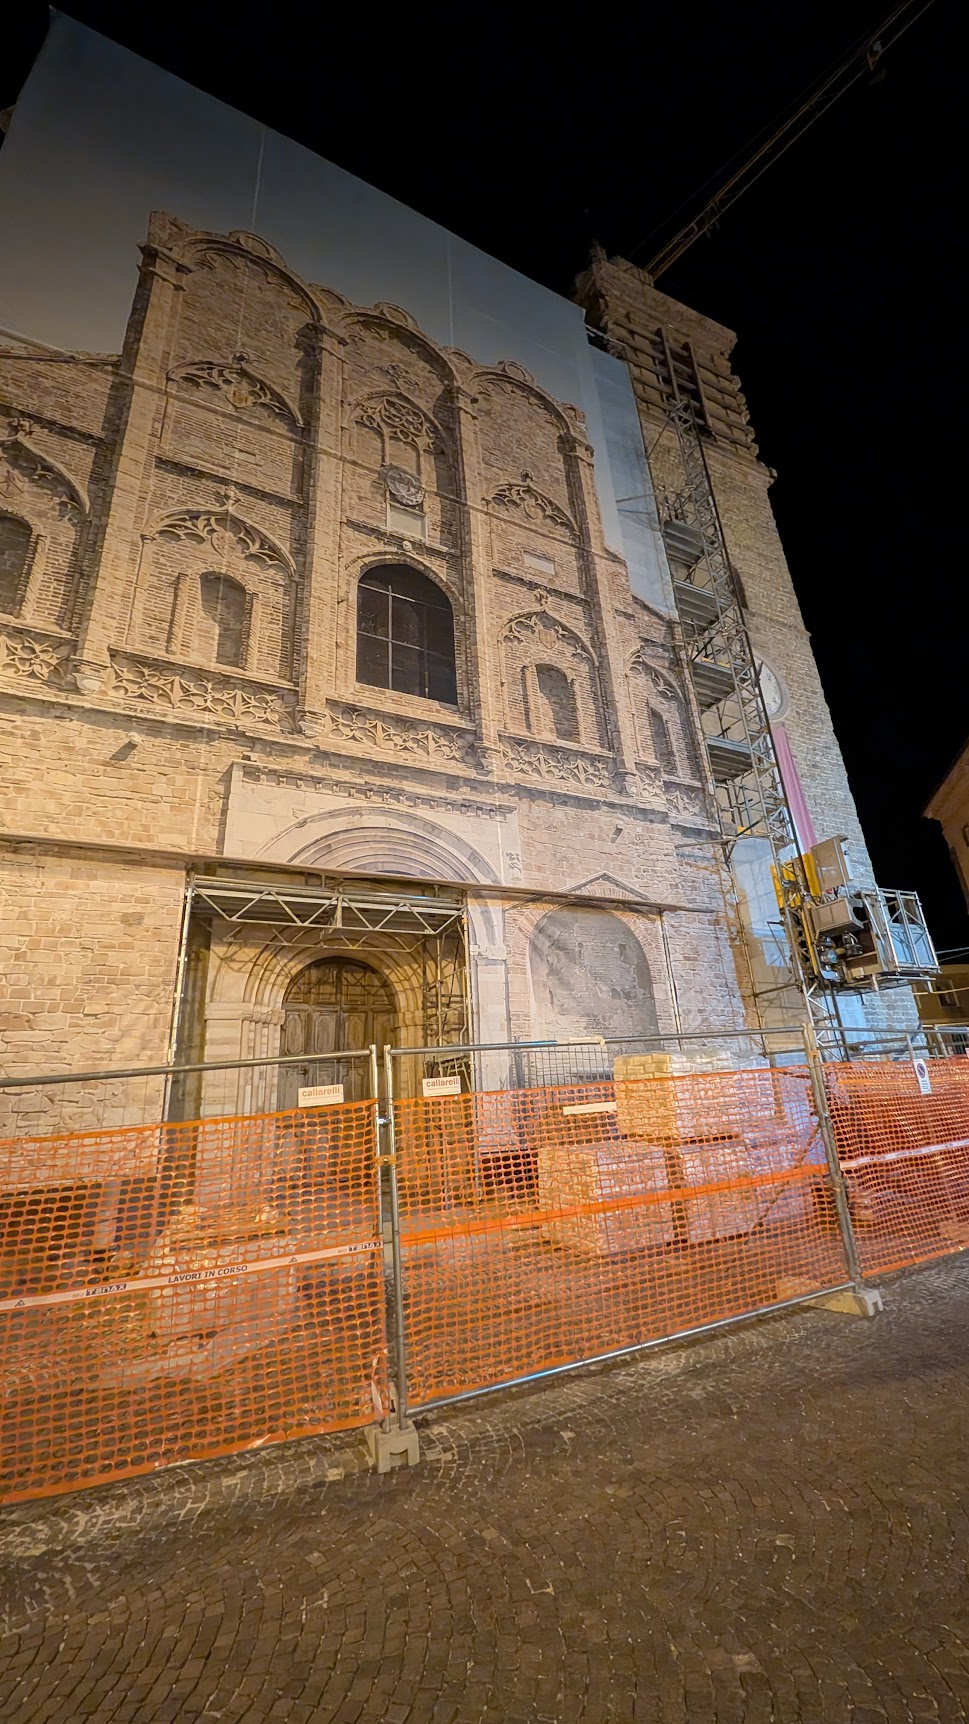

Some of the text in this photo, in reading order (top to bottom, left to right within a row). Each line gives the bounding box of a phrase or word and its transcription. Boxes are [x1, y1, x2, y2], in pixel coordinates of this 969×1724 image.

[426, 1078, 459, 1087] callarelli
[302, 1086, 340, 1097] callarelli
[168, 1265, 248, 1283] LAVORI IN CORSO
